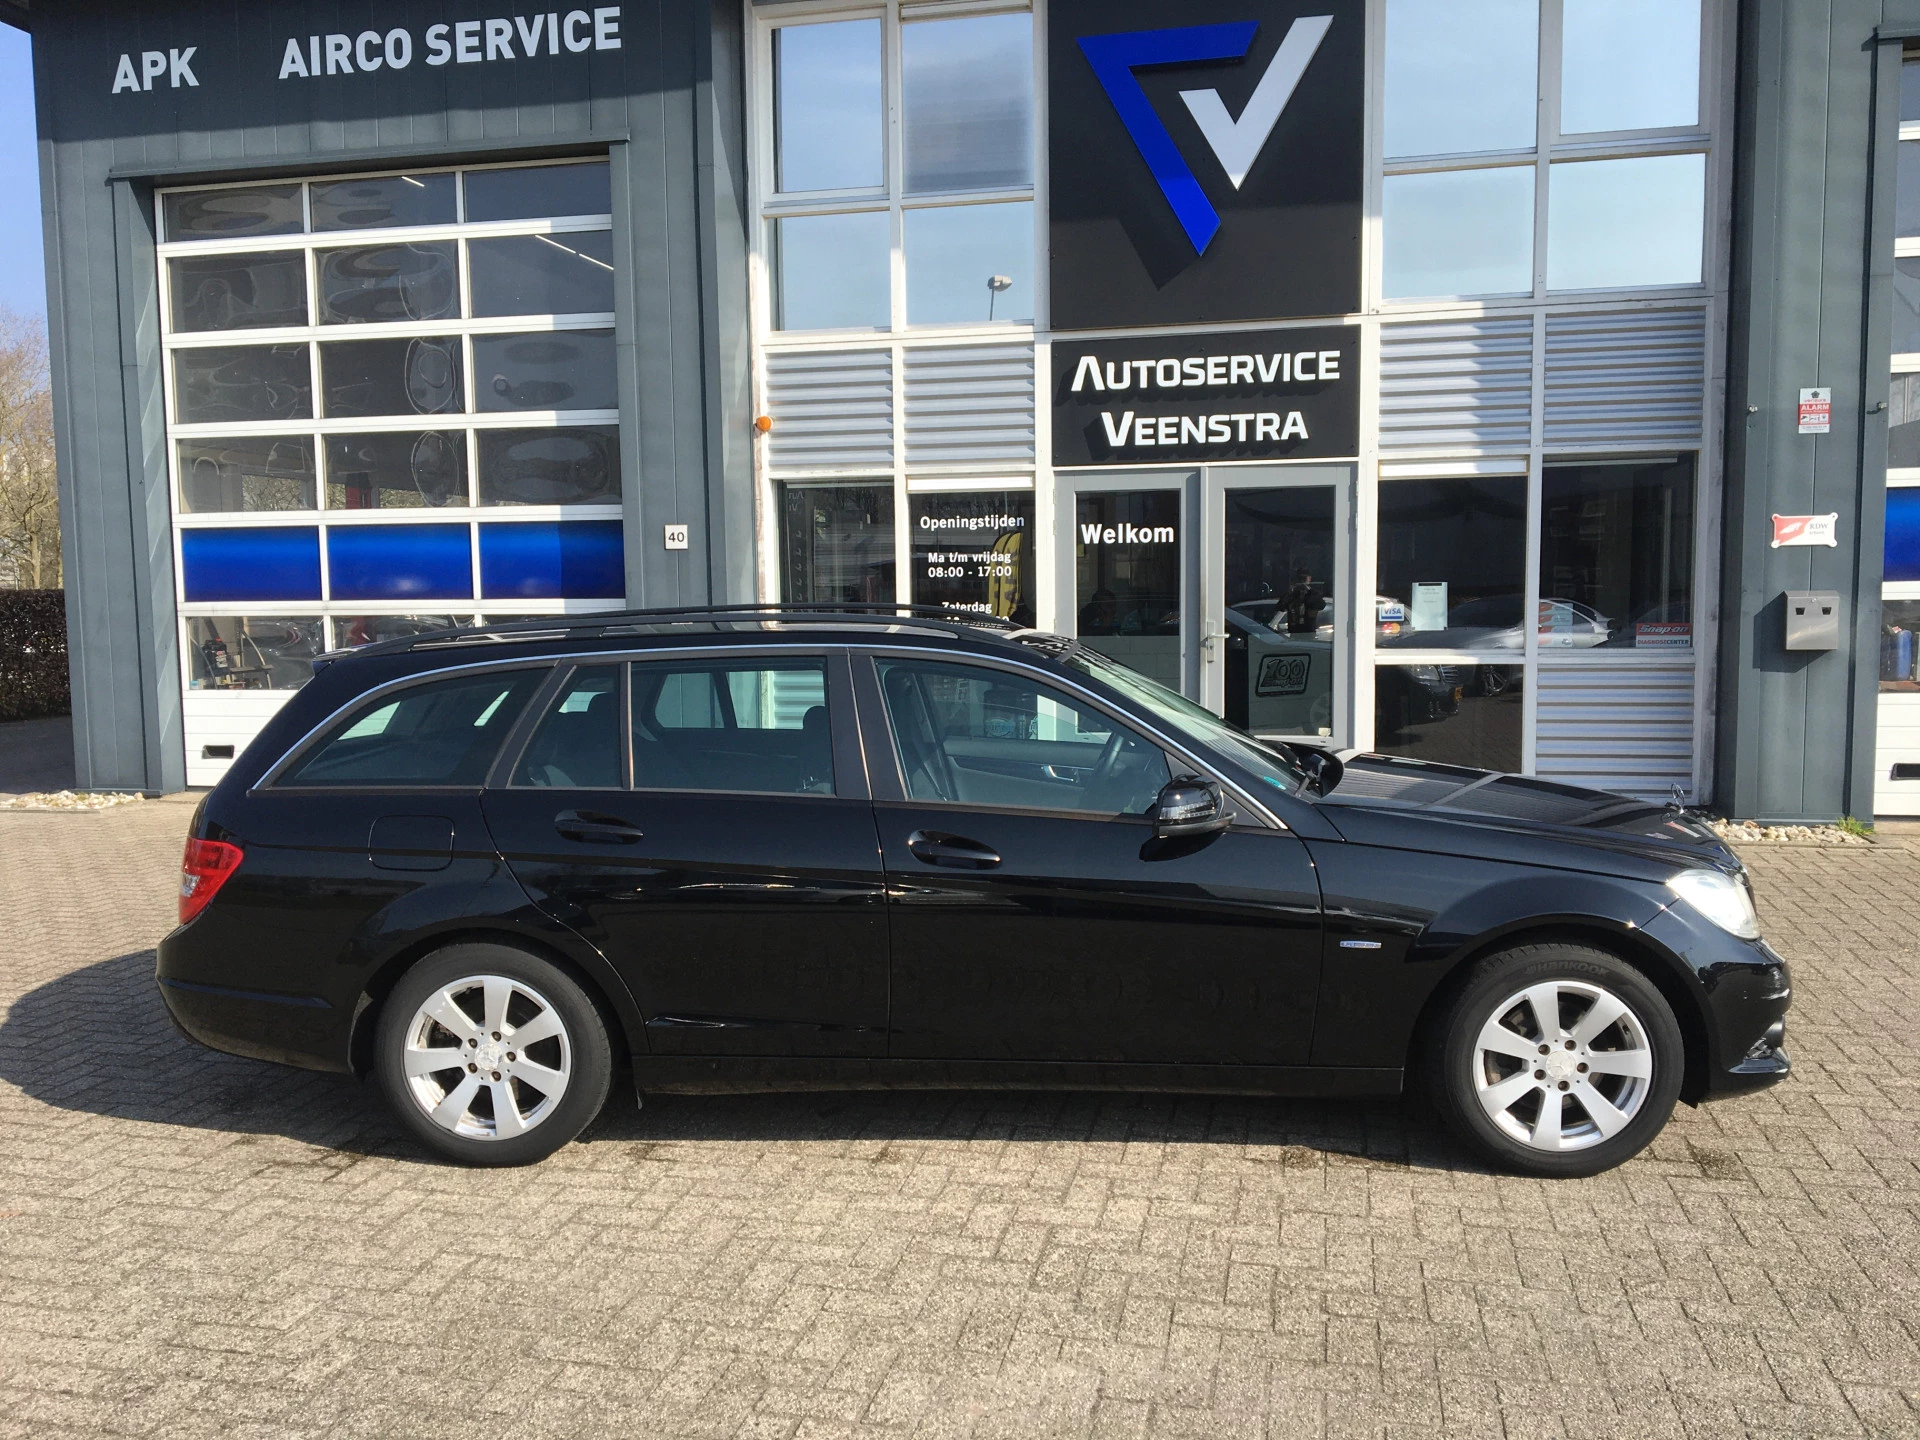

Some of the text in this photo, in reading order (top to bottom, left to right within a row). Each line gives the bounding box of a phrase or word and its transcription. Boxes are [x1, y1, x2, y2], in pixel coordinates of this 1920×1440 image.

[278, 6, 622, 80] AIRCO SERVICE
[111, 46, 199, 94] APK
[1071, 350, 1341, 392] AUTOSERVICE
[1101, 411, 1309, 447] VEENSTRA
[920, 515, 1025, 531] Openingstijden
[1809, 522, 1828, 530] RDW
[668, 532, 685, 542] 40
[1081, 523, 1174, 544] Welkom
[928, 551, 1011, 564] Ma t/m vrijdag
[928, 567, 964, 577] 08:00
[977, 566, 1012, 577] 17:00
[941, 601, 993, 614] Zaterdag
[1639, 625, 1689, 634] Snap-on
